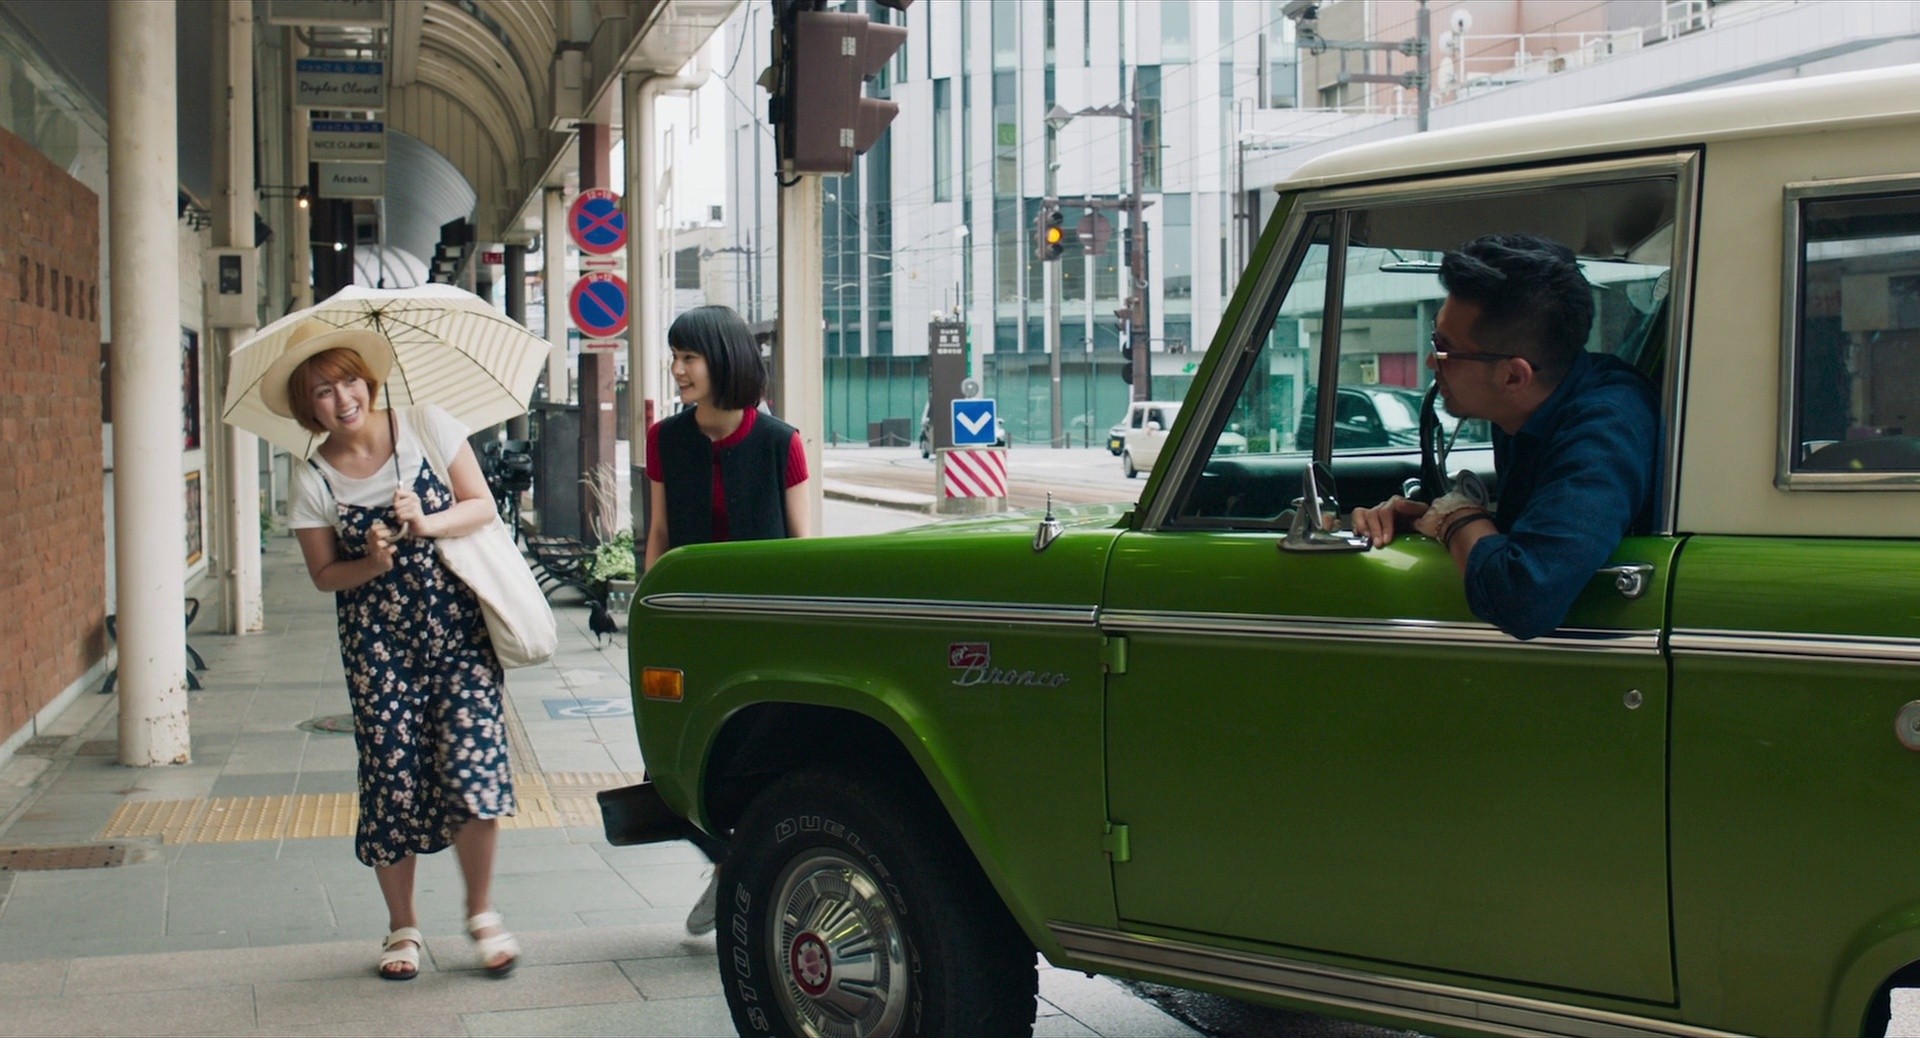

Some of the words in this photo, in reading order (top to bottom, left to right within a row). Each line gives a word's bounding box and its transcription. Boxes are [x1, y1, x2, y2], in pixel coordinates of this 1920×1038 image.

[300, 81, 338, 95] Duplex
[341, 81, 379, 94] Closet
[314, 141, 335, 149] NICE
[333, 174, 368, 184] Acacia
[952, 652, 1070, 688] Bronco
[775, 815, 907, 915] DUELER
[732, 883, 769, 1033] STONE
